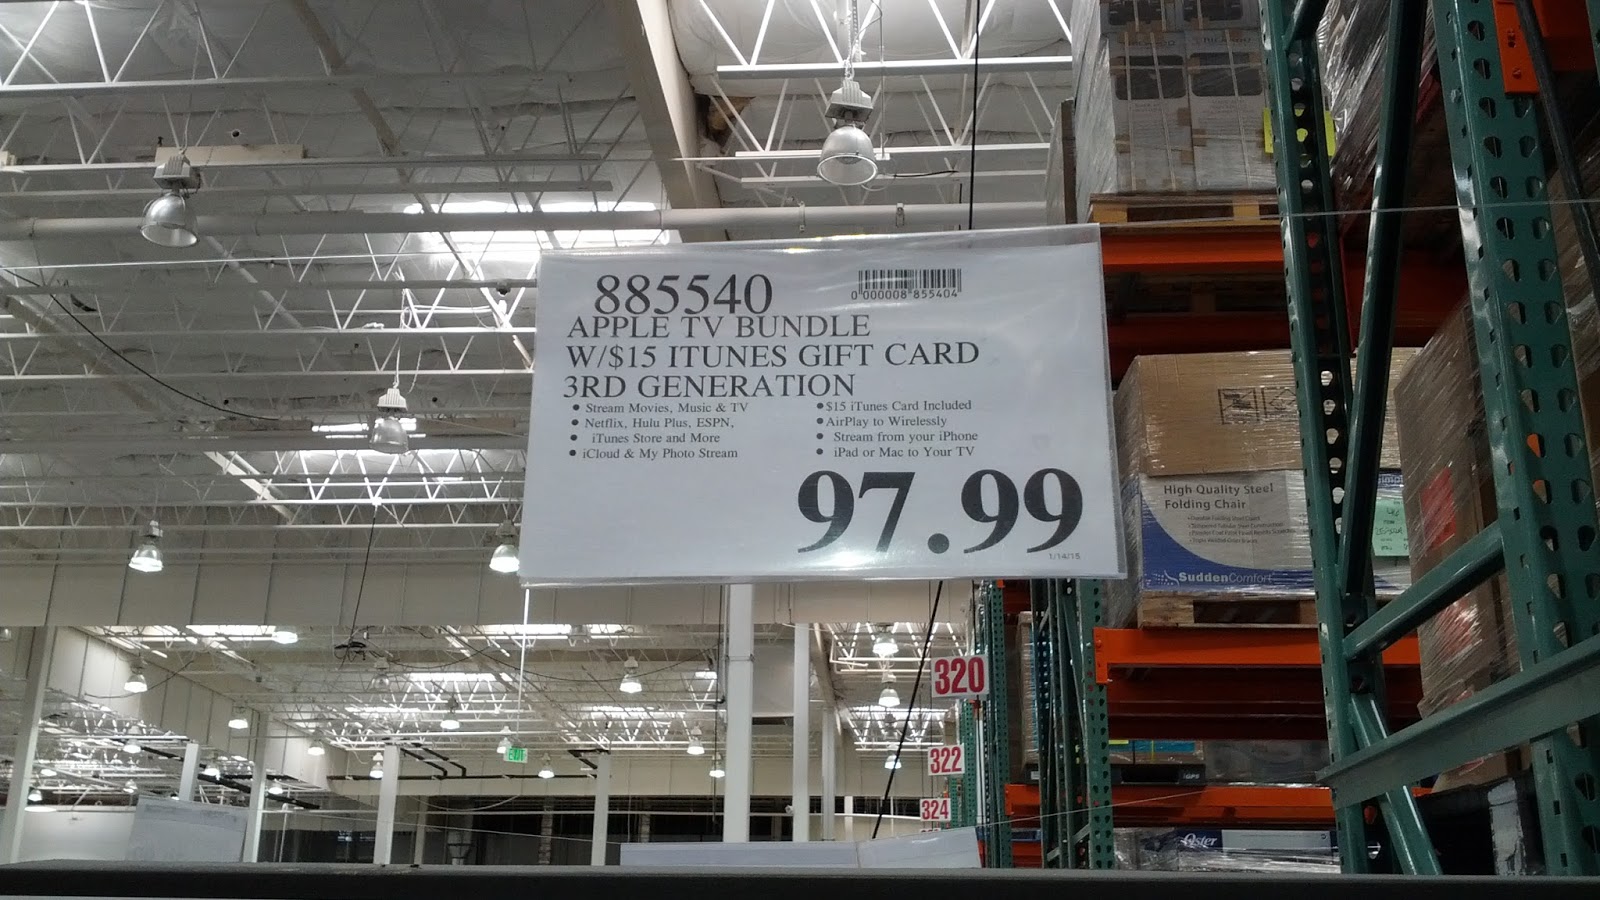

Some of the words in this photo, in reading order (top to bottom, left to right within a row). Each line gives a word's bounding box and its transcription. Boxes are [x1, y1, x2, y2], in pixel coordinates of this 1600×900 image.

[594, 274, 773, 316] 885540
[566, 315, 670, 339] APPLE
[681, 315, 725, 338] TV
[735, 314, 870, 338] BUNDLE
[566, 344, 657, 371] W/$15
[668, 345, 788, 369] ITUNES
[799, 343, 873, 367] GIFT
[885, 342, 980, 366] CARD
[563, 375, 627, 399] 3RD
[637, 374, 856, 399] GENERATION
[585, 403, 624, 413] Stream
[628, 403, 673, 414] Movies,
[678, 402, 712, 413] Music
[715, 403, 727, 413] &
[730, 402, 749, 413] TV
[825, 401, 847, 412] $15
[850, 401, 888, 412] iTunes
[891, 401, 919, 411] Card
[923, 400, 972, 411] Included
[585, 418, 628, 429] Netflix,
[632, 418, 660, 428] Hulu
[664, 417, 692, 429] Plus,
[696, 417, 735, 429] ESPN,
[825, 417, 869, 429] AirPlay
[873, 417, 884, 427] to
[888, 415, 948, 428] Wirelessly
[592, 433, 629, 443] iTunes
[633, 433, 663, 443] Store
[665, 433, 686, 443] and
[690, 433, 721, 443] More
[833, 432, 873, 442] Stream
[877, 431, 905, 442] from
[908, 433, 936, 444] your
[939, 431, 979, 441] iPhone
[582, 448, 620, 459] iCloud
[624, 449, 635, 459] &
[639, 448, 659, 461] My
[662, 448, 695, 458] Photo
[698, 448, 738, 458] Stream
[834, 447, 859, 457] iPad
[862, 449, 875, 457] or
[879, 447, 904, 457] Mac
[907, 448, 919, 457] to
[923, 446, 953, 457] Your
[956, 446, 975, 456] TV
[1164, 484, 1192, 497] High
[1196, 484, 1240, 497] Quality
[1244, 482, 1274, 495] Steel
[797, 468, 1084, 556] 97.99
[1165, 499, 1211, 511] Folding
[1214, 499, 1247, 509] Chair
[934, 656, 985, 695] 320
[930, 746, 962, 774] 322
[921, 799, 950, 820] 324
[1180, 833, 1218, 849] Oster
